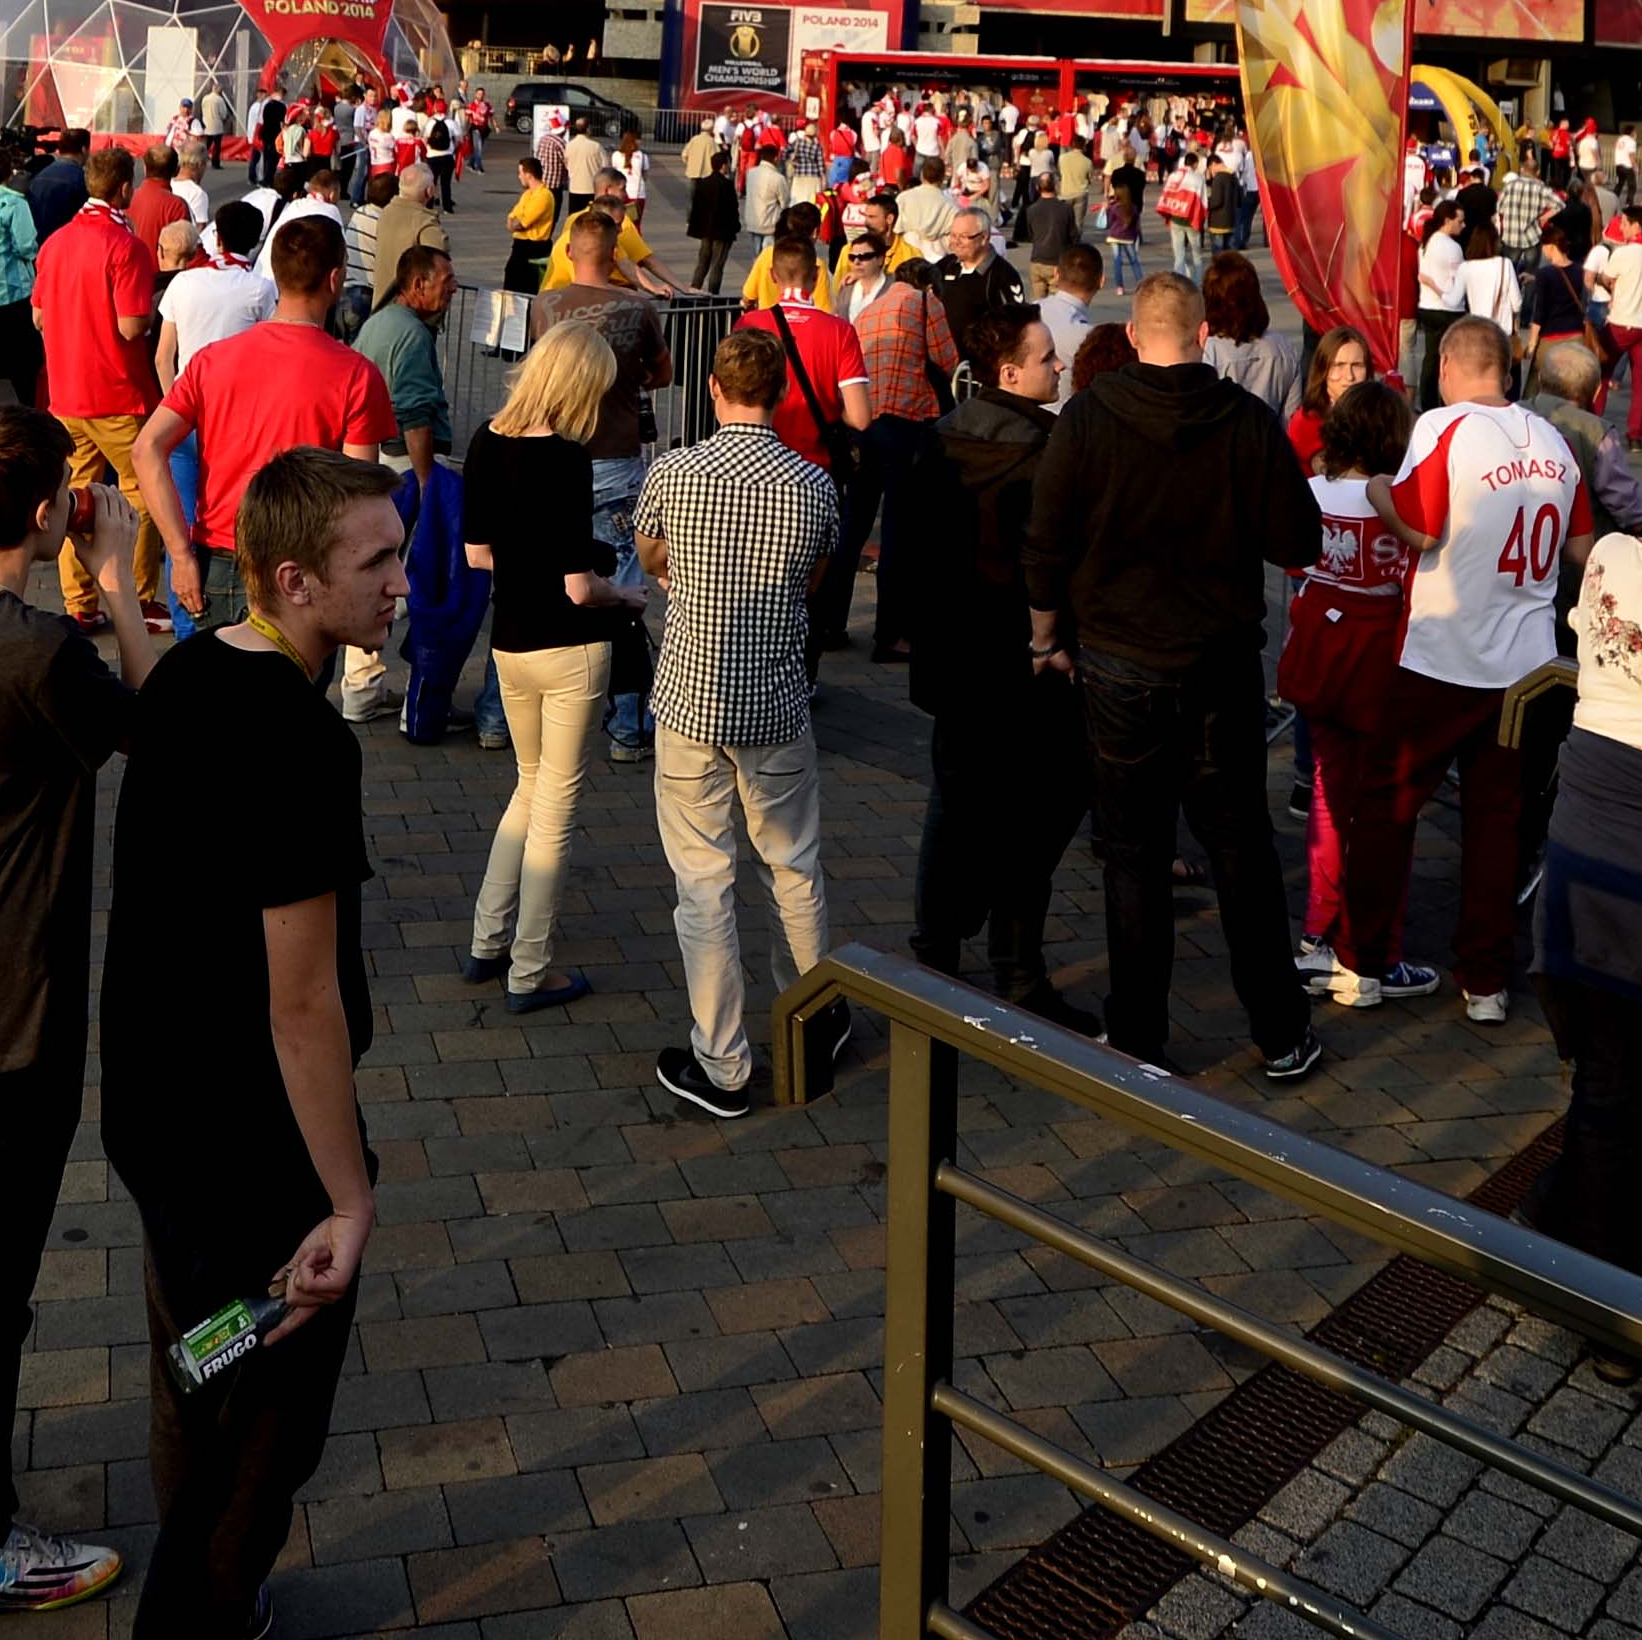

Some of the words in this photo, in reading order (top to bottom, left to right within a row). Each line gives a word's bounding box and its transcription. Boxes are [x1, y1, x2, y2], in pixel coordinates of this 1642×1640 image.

[340, 2, 375, 19] 2014
[730, 10, 762, 23] FIVB
[803, 15, 851, 27] POLAND
[853, 16, 879, 28] 2014
[708, 65, 739, 75] MEN'S
[741, 66, 778, 77] WORLD
[704, 73, 781, 86] CHAMPIONSHIP
[1481, 459, 1566, 491] TOMASZ
[1498, 503, 1561, 587] 40
[203, 1333, 257, 1379] FRUGO
